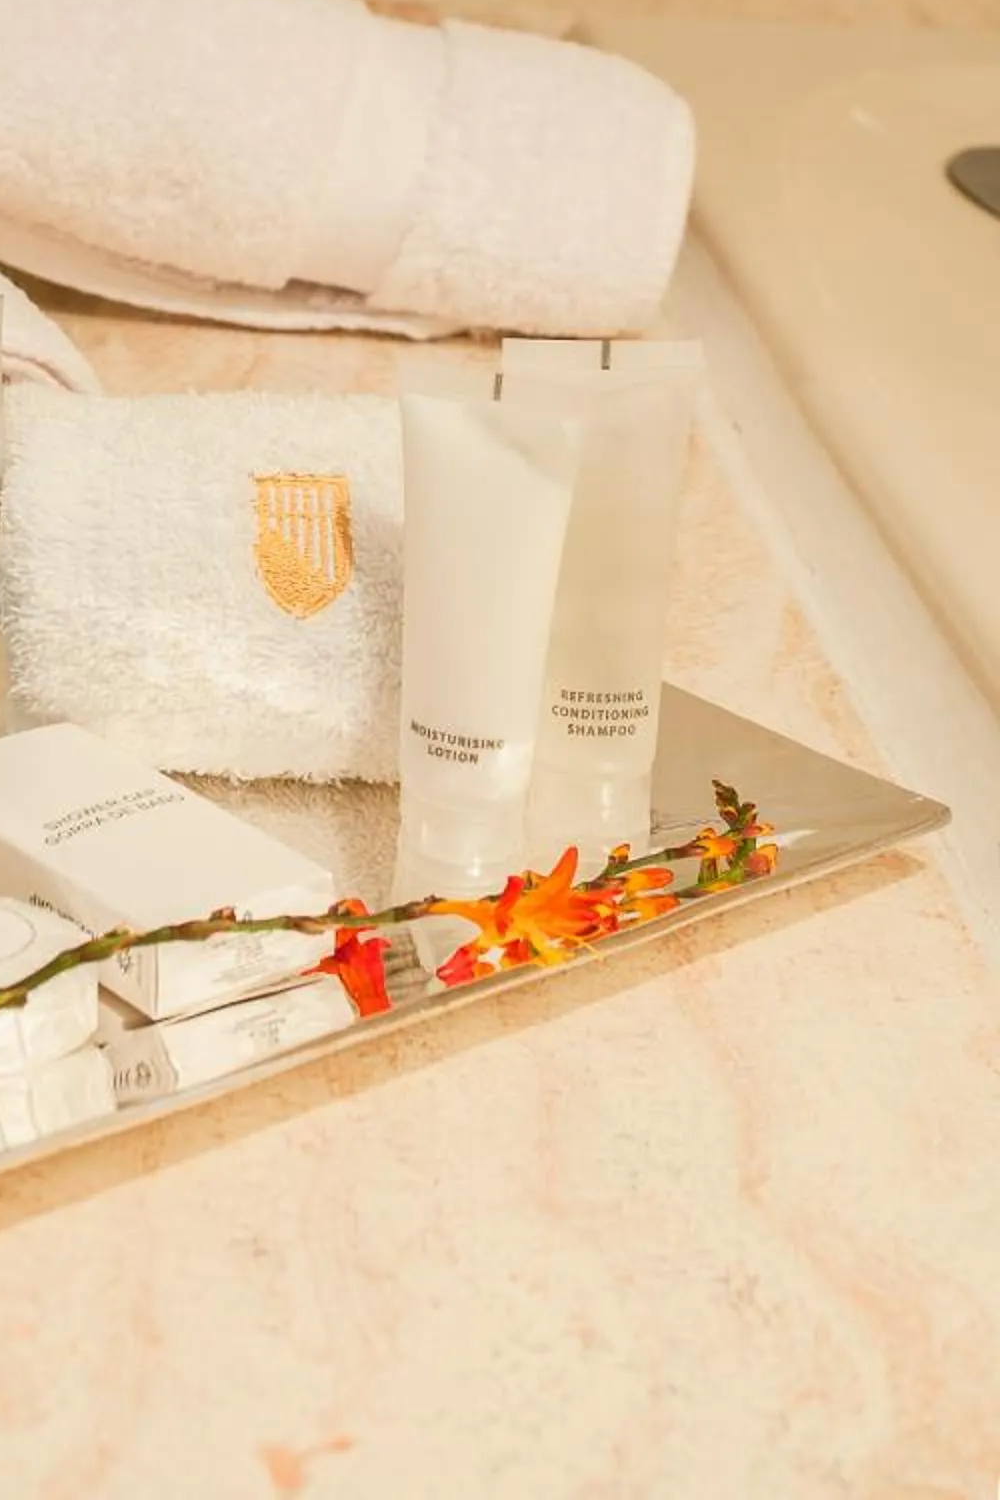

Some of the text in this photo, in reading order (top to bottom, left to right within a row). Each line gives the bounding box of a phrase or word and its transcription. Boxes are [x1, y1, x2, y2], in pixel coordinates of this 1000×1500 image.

[560, 688, 644, 705] REFRESHING
[551, 704, 650, 720] CONDITIONING
[410, 719, 506, 750] MOISTURISING
[566, 723, 637, 737] SHAMPOO
[427, 744, 480, 765] LOTION
